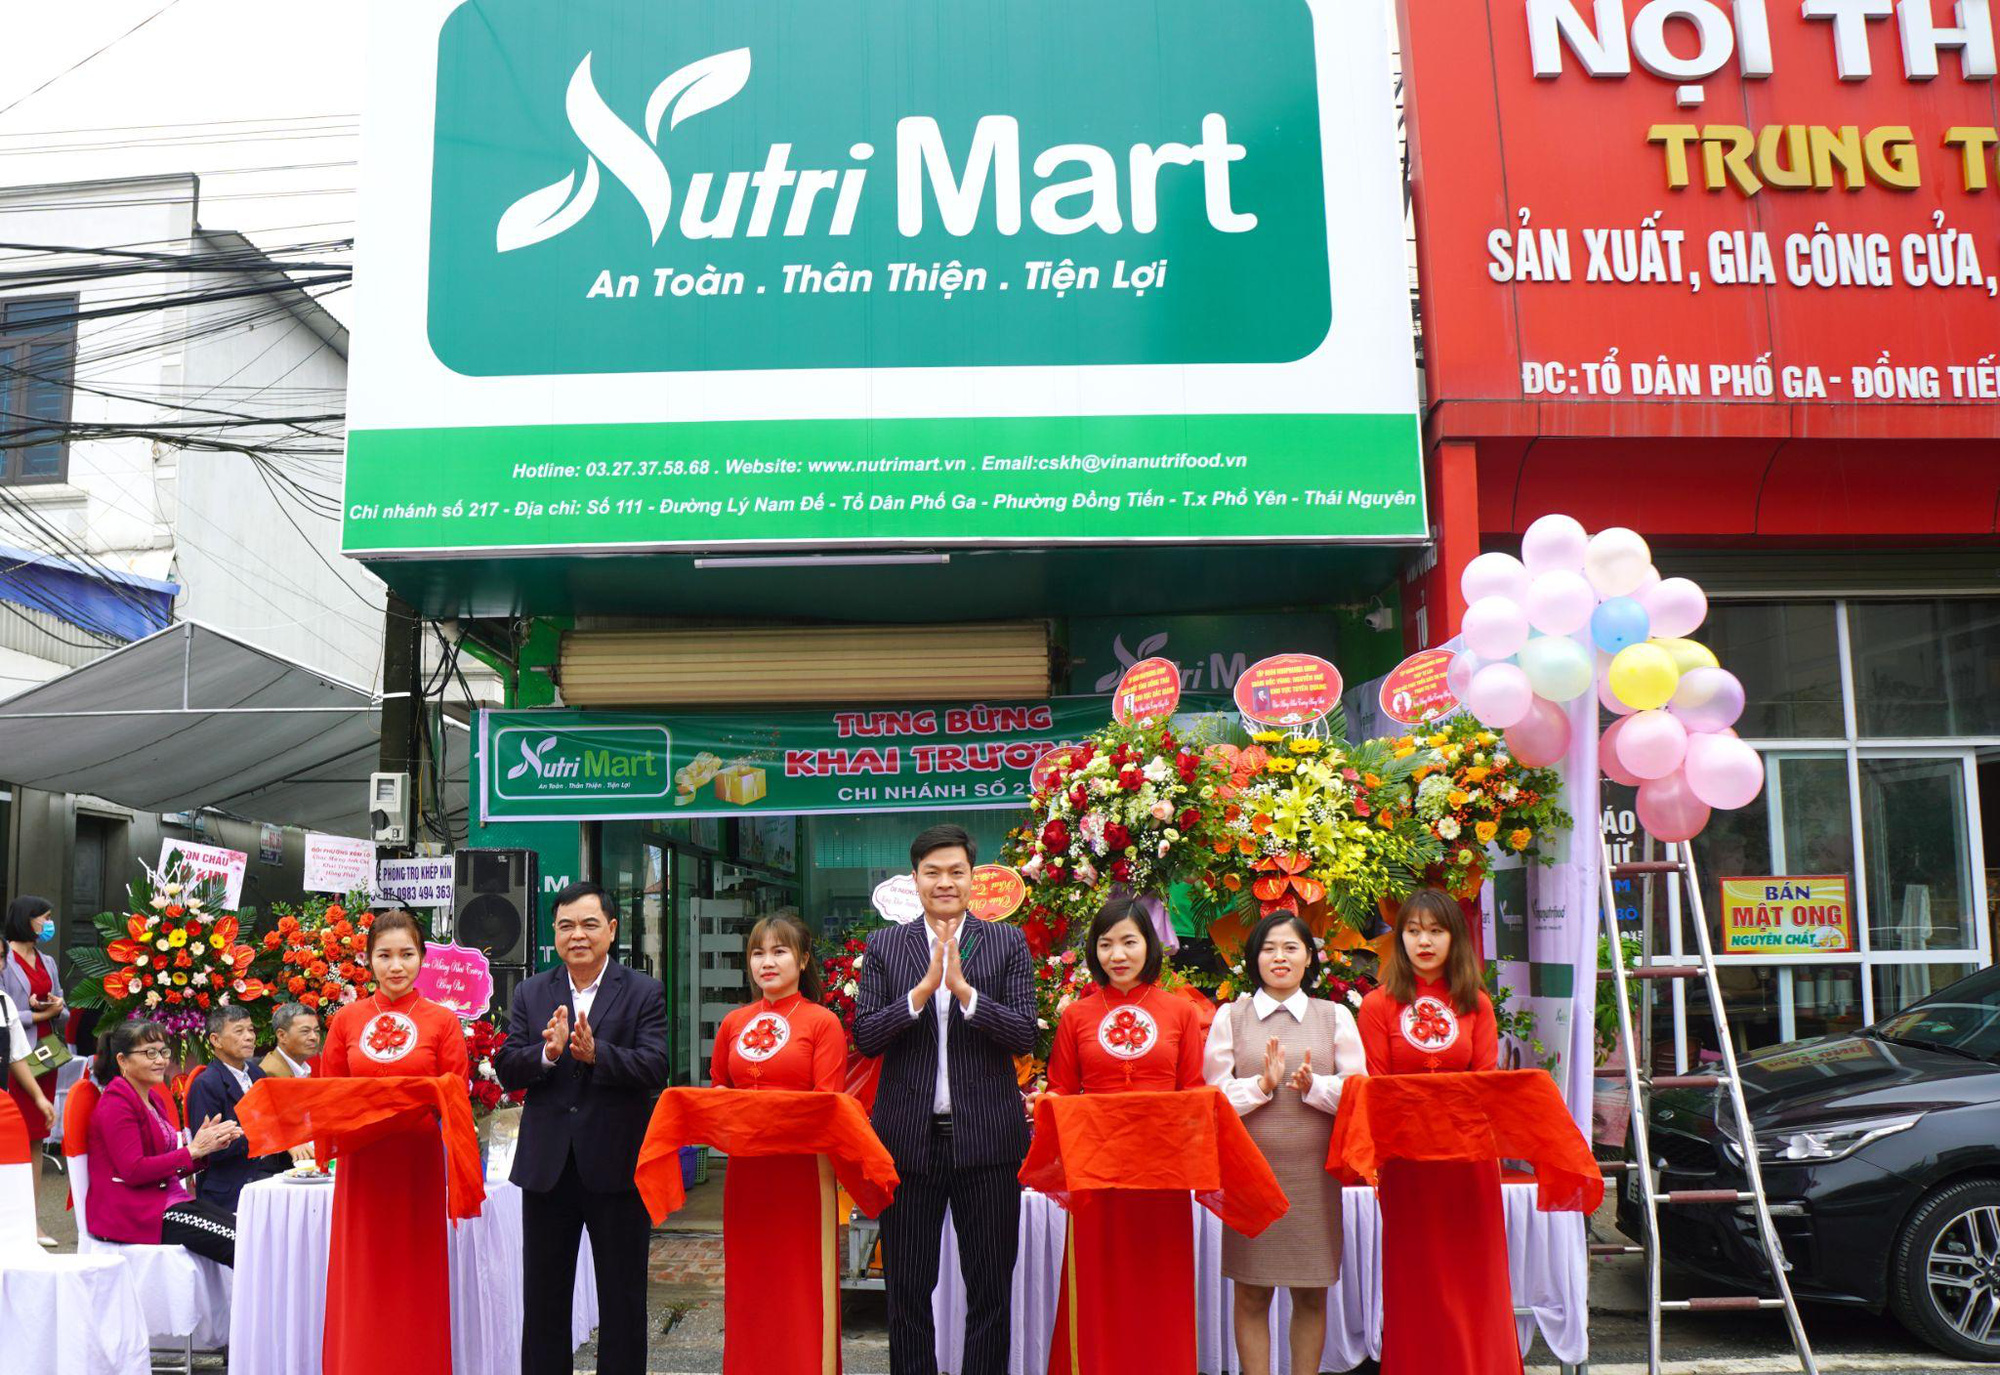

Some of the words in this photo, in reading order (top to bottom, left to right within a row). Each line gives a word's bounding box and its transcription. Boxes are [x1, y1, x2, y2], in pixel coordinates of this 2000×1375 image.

[497, 47, 874, 253] Nutri
[896, 112, 1258, 237] Mart
[1646, 124, 1922, 198] TRUNG
[1943, 126, 2000, 193] T
[1487, 207, 1571, 283] SẢN
[1708, 230, 1777, 286] GIA
[1785, 221, 1894, 289] CÔNG
[1901, 209, 1998, 297] CỬA,
[586, 270, 638, 299] An
[653, 263, 744, 298] Toàn
[782, 261, 879, 294] Thân
[887, 260, 987, 300] Thiện
[1025, 258, 1099, 298] Tiện
[1113, 259, 1168, 297] Lợi
[1631, 355, 1701, 397] DÂN
[1711, 352, 1774, 398] PHỐ
[1782, 366, 1826, 399] GA
[1851, 351, 1940, 400] ĐỒNG
[1947, 354, 2000, 399] TIẾ
[513, 463, 580, 477] Hotline:
[586, 460, 709, 476] 03.27.37.58.68
[727, 459, 802, 473] Website:
[809, 457, 965, 472] www.nutrimart.vn
[982, 453, 1247, 473] Email:cskh@vinanutrifood.vn
[350, 505, 378, 519] Chi
[383, 504, 436, 518] nhánh
[442, 500, 463, 517] số
[469, 502, 499, 516] 217
[515, 502, 543, 518] Địa
[549, 500, 581, 515] chỉ:
[587, 497, 610, 514] Số
[617, 500, 642, 513] 111
[660, 499, 722, 516] Đường
[728, 498, 749, 515] Lý
[755, 497, 794, 511] Nam
[800, 493, 824, 510] Đế
[843, 493, 863, 510] Tổ
[870, 495, 904, 509] Dân
[911, 492, 945, 509] Phố
[952, 494, 975, 509] Ga
[994, 494, 1067, 511] Phường
[1073, 491, 1120, 511] Đồng
[1128, 490, 1164, 506] Tiến
[1183, 492, 1206, 506] T.x
[1213, 488, 1248, 505] Phổ
[1254, 491, 1287, 505] Yên
[1305, 491, 1342, 504] Thái
[1348, 490, 1415, 508] Nguyên
[834, 711, 937, 738] TƯNG
[945, 703, 1053, 733] BỪNG
[507, 736, 581, 779] Nutri
[584, 749, 657, 778] Mart
[785, 747, 900, 777] KHAI
[838, 786, 877, 801] CHI
[884, 782, 966, 799] NHÁNH
[974, 778, 1006, 796] SỐ
[407, 866, 419, 884] TRỌ
[440, 862, 452, 880] KÍN
[419, 886, 434, 900] 494
[1765, 881, 1811, 901] BÁN
[1732, 902, 1784, 932] MẬT
[1792, 904, 1843, 927] ONG
[1731, 932, 1782, 946] NGUYÊN
[1785, 929, 1817, 945] CHẤT
